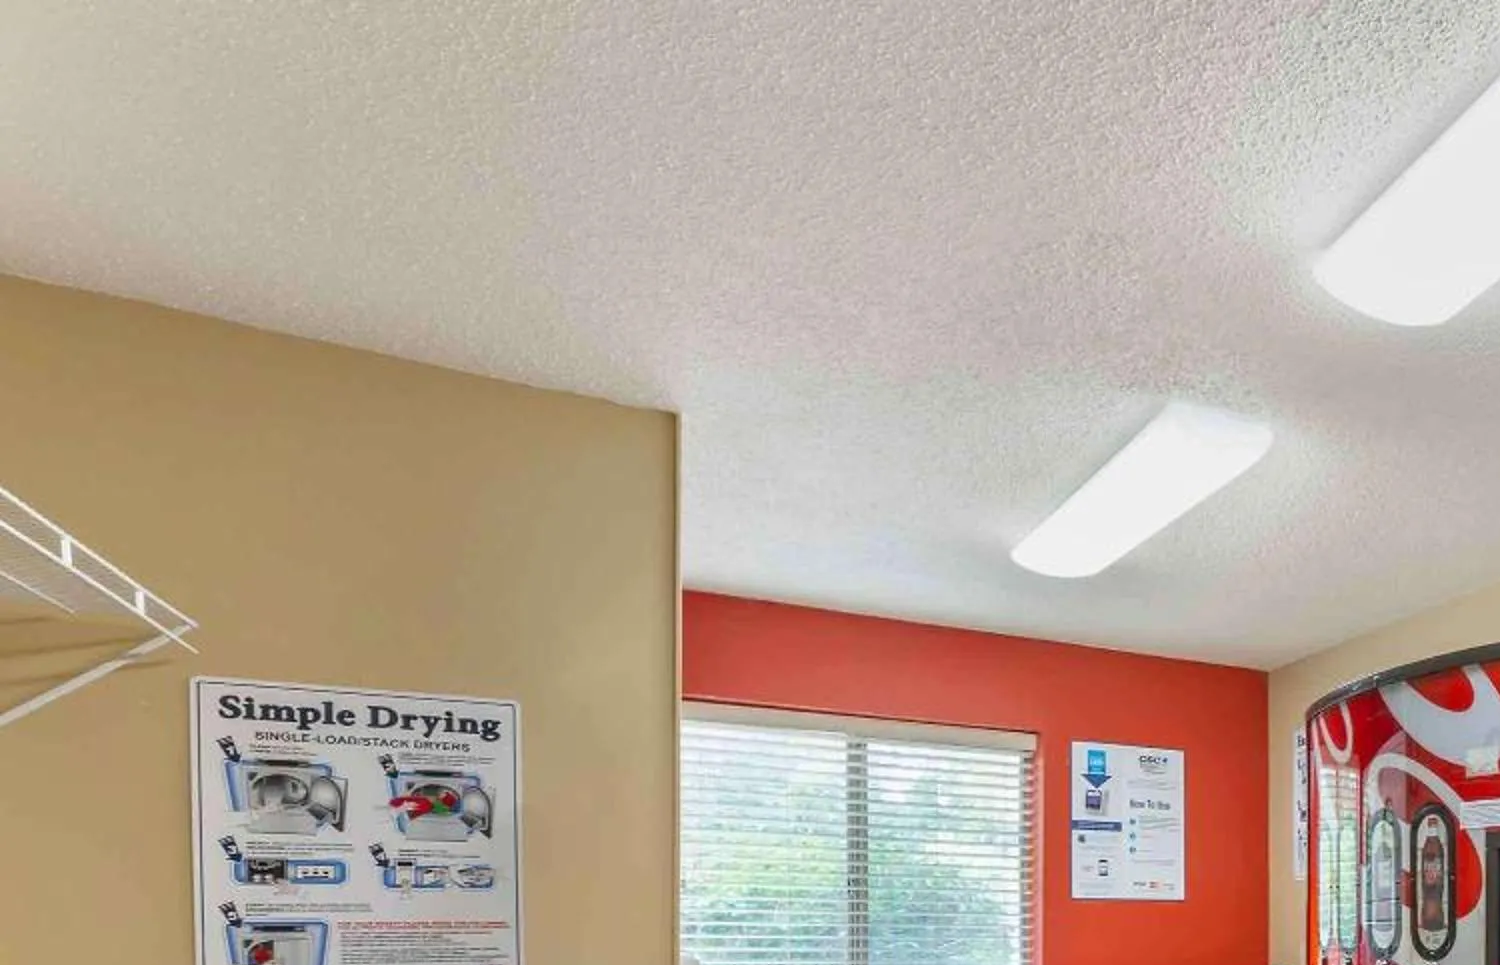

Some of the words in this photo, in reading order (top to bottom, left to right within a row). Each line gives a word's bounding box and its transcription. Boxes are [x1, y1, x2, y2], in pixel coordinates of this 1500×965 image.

[218, 695, 356, 731] Simple
[367, 705, 502, 742] Drying
[413, 740, 471, 753] DRYERS
